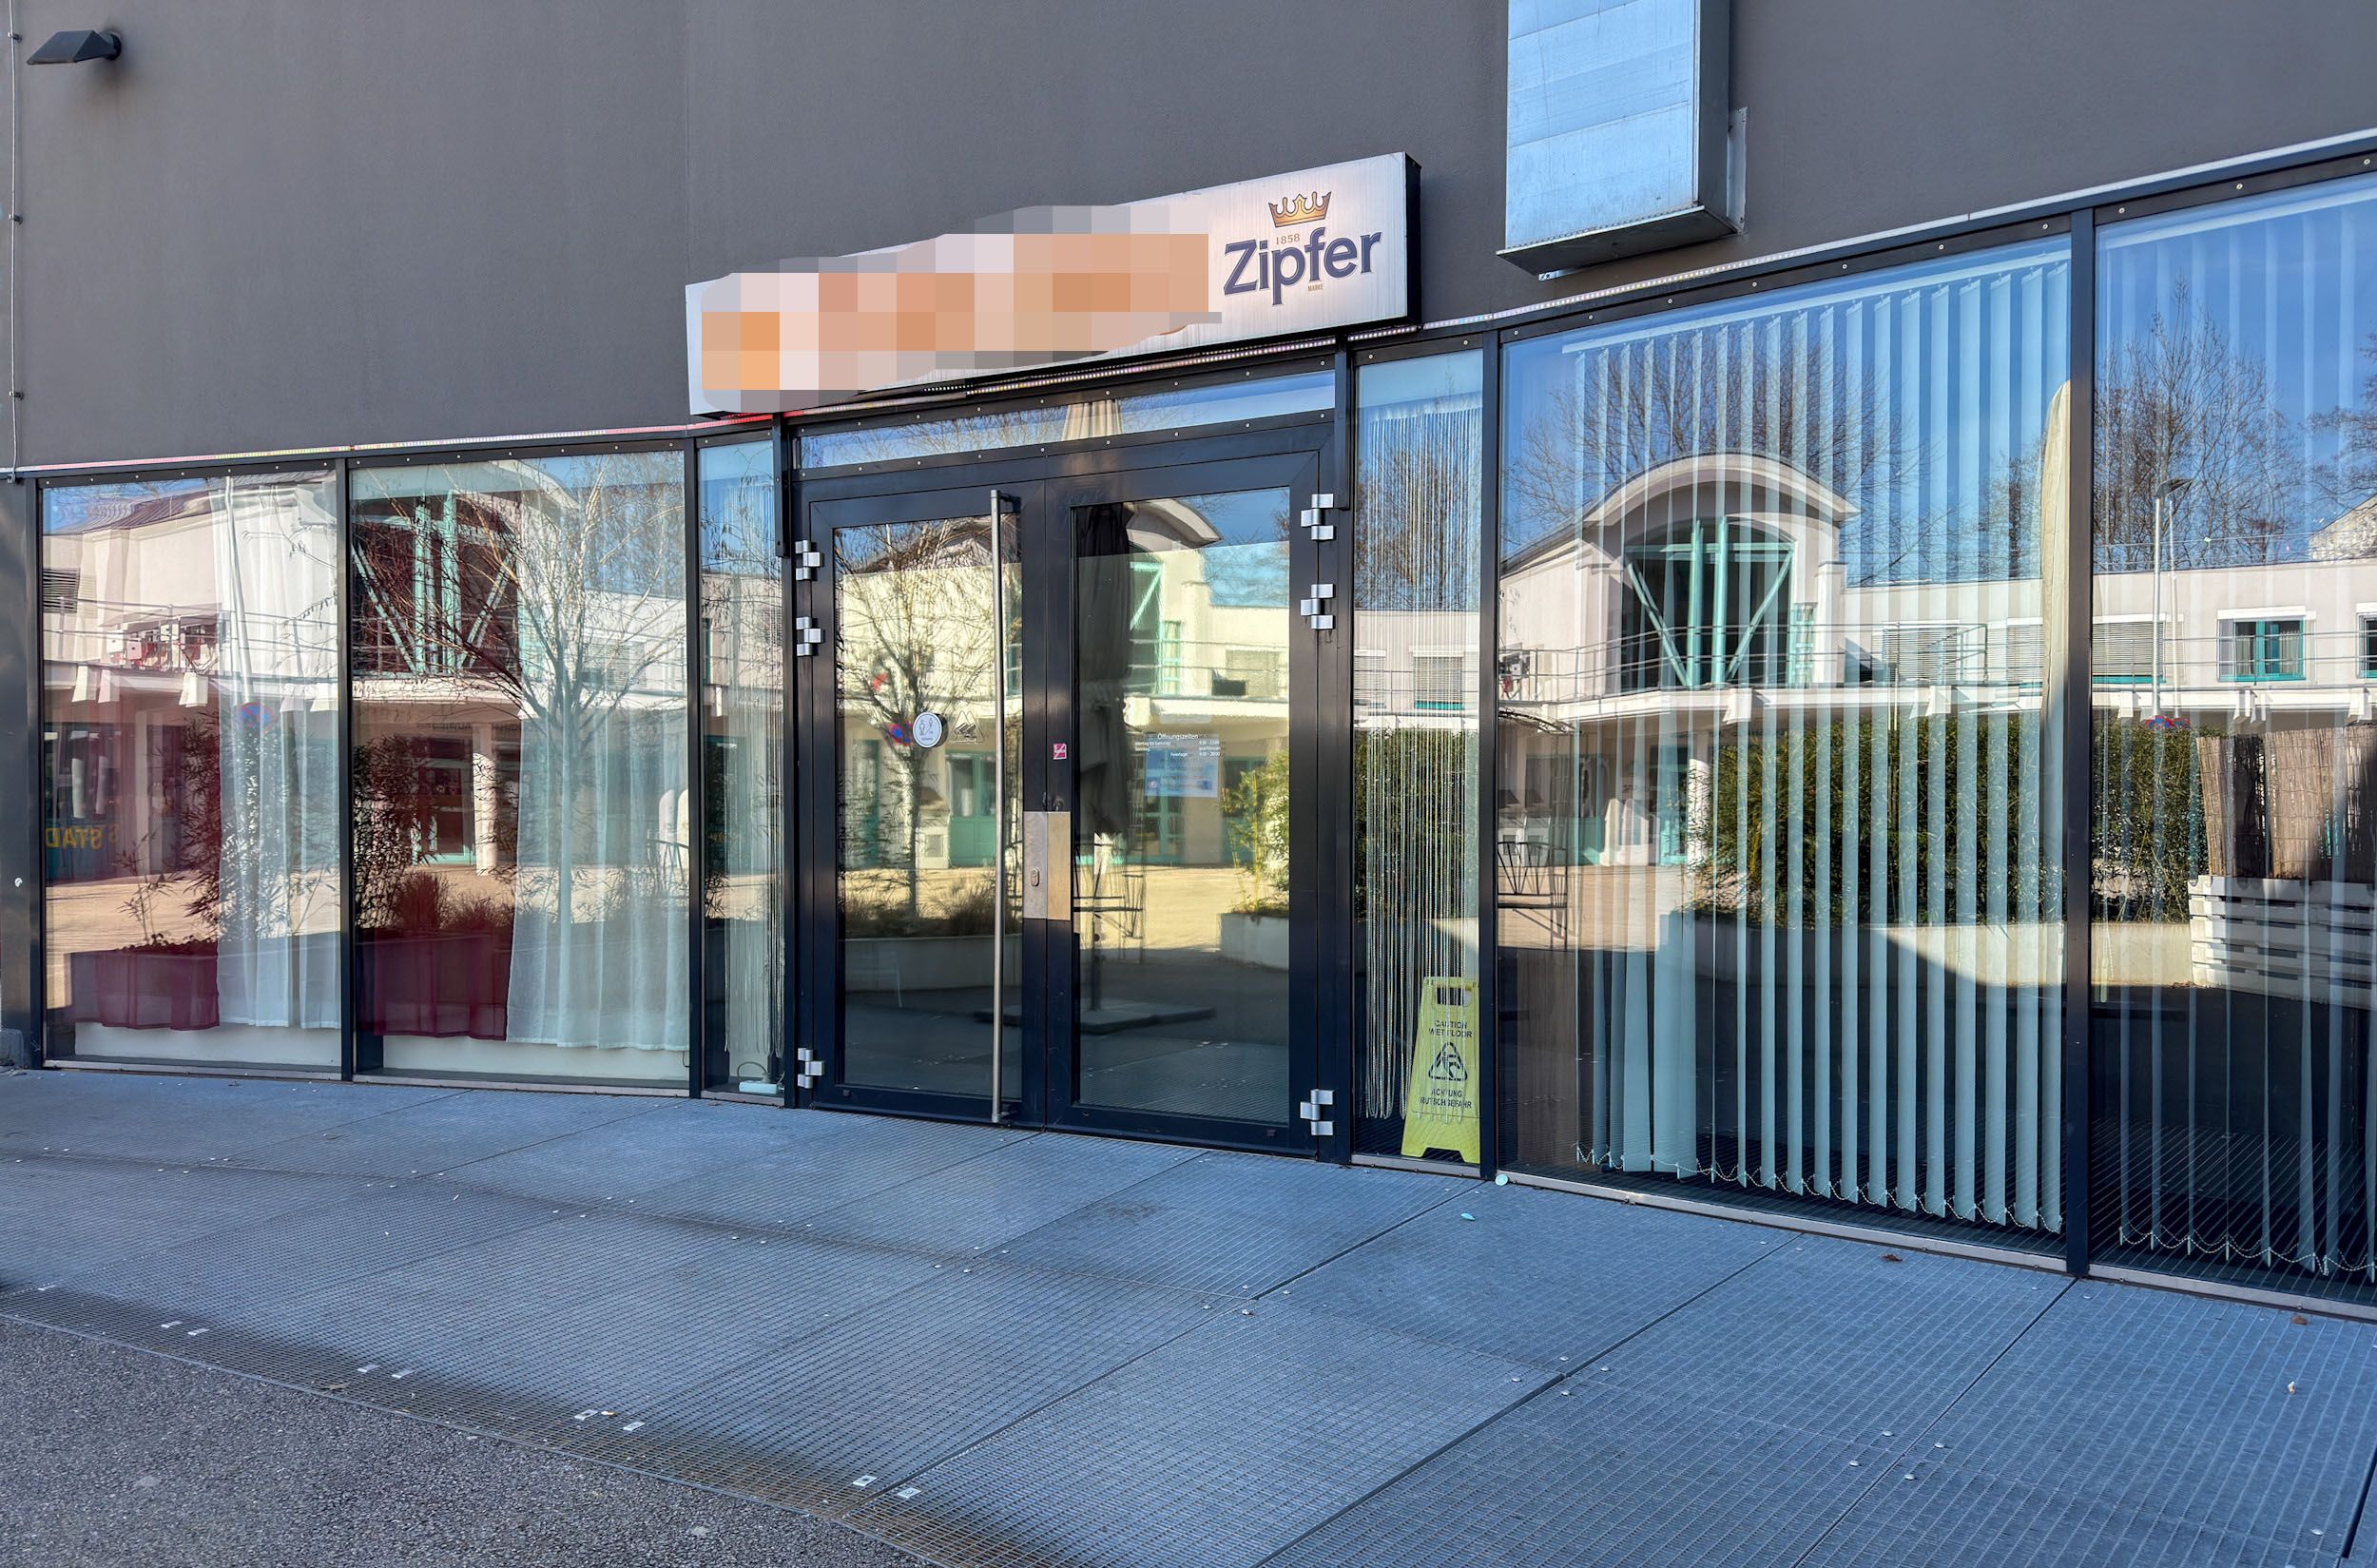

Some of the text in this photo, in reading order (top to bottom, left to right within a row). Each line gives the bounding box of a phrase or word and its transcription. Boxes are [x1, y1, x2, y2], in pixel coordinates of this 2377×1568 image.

[1276, 233, 1300, 244] 1858
[1224, 227, 1382, 305] Zipfer
[1429, 1027, 1445, 1036] WET
